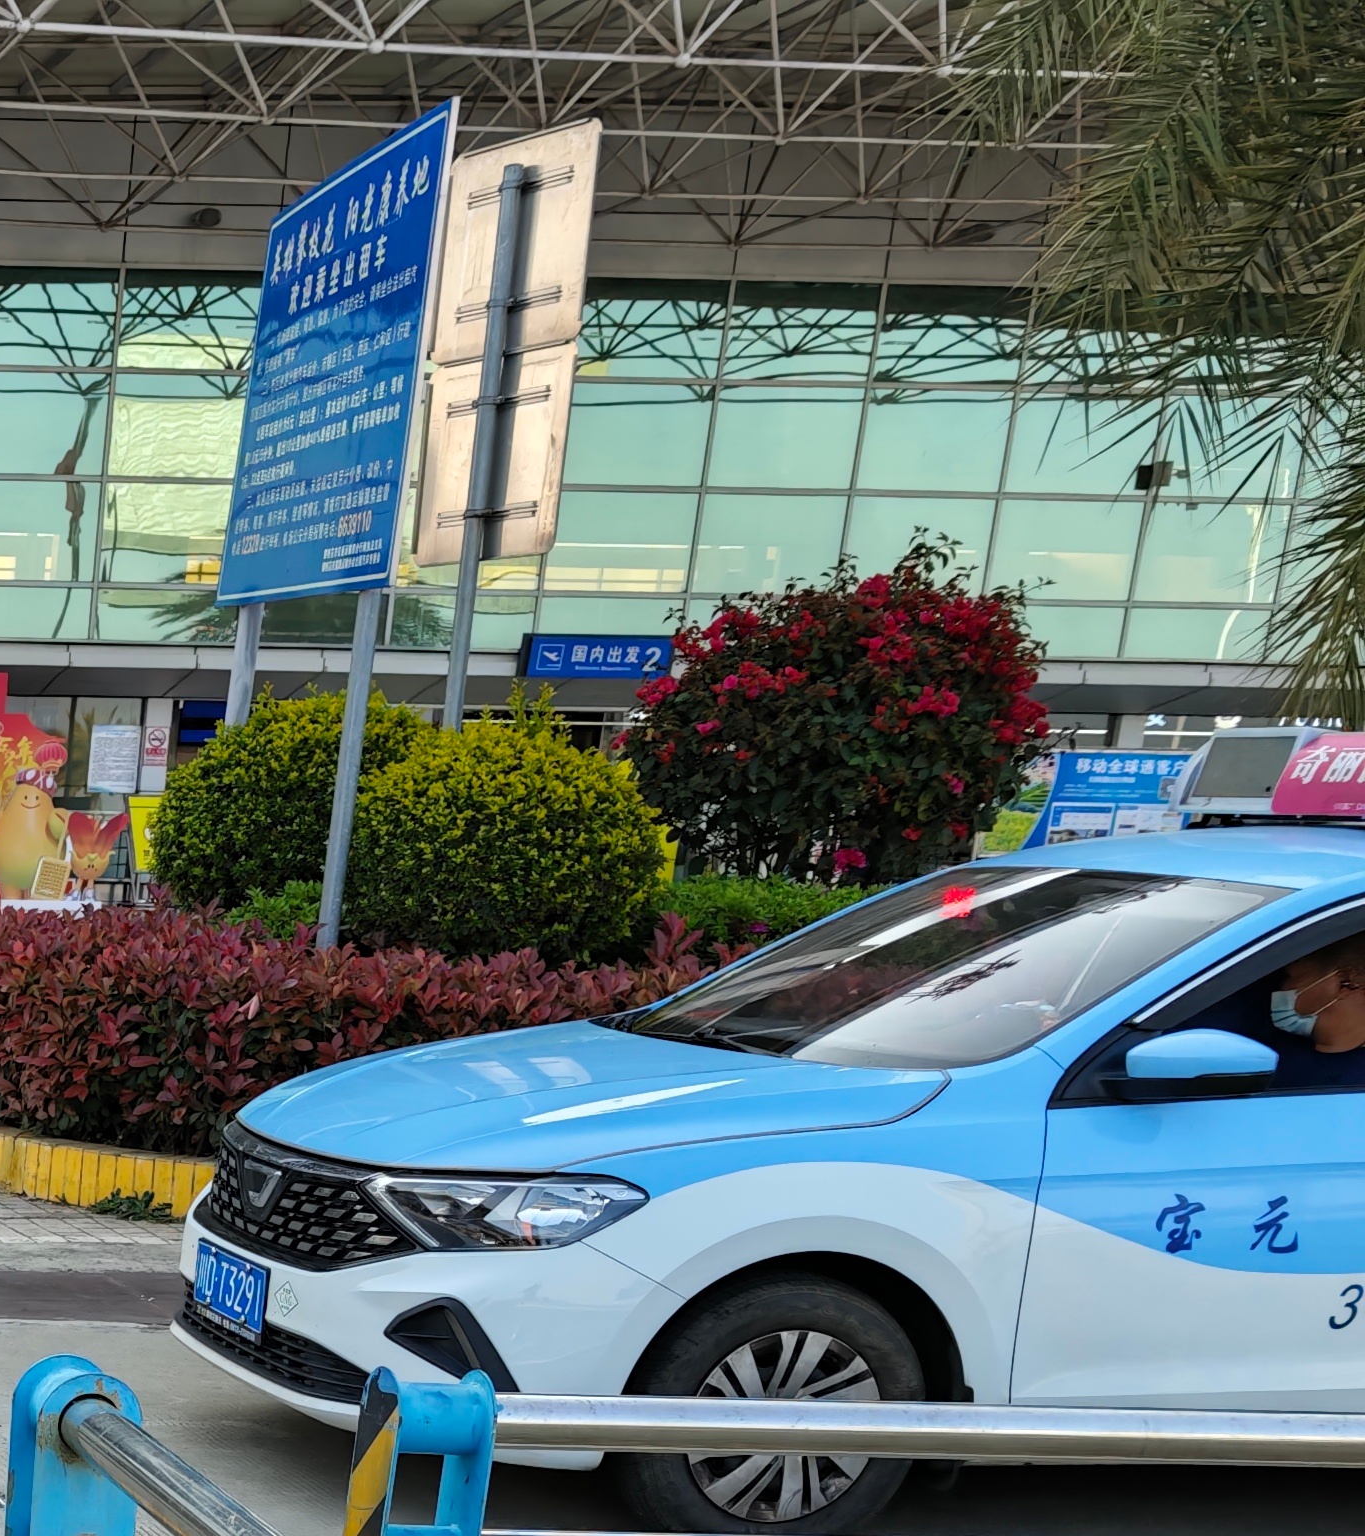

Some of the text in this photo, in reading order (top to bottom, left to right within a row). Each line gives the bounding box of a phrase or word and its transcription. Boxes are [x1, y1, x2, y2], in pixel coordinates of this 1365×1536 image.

[288, 234, 388, 315] 欢迎乘坐出租车
[571, 645, 662, 672] 国内出发 2
[1290, 746, 1365, 784] 奇丽
[1156, 1193, 1298, 1254] 宝元
[1329, 1284, 1364, 1330] 3
